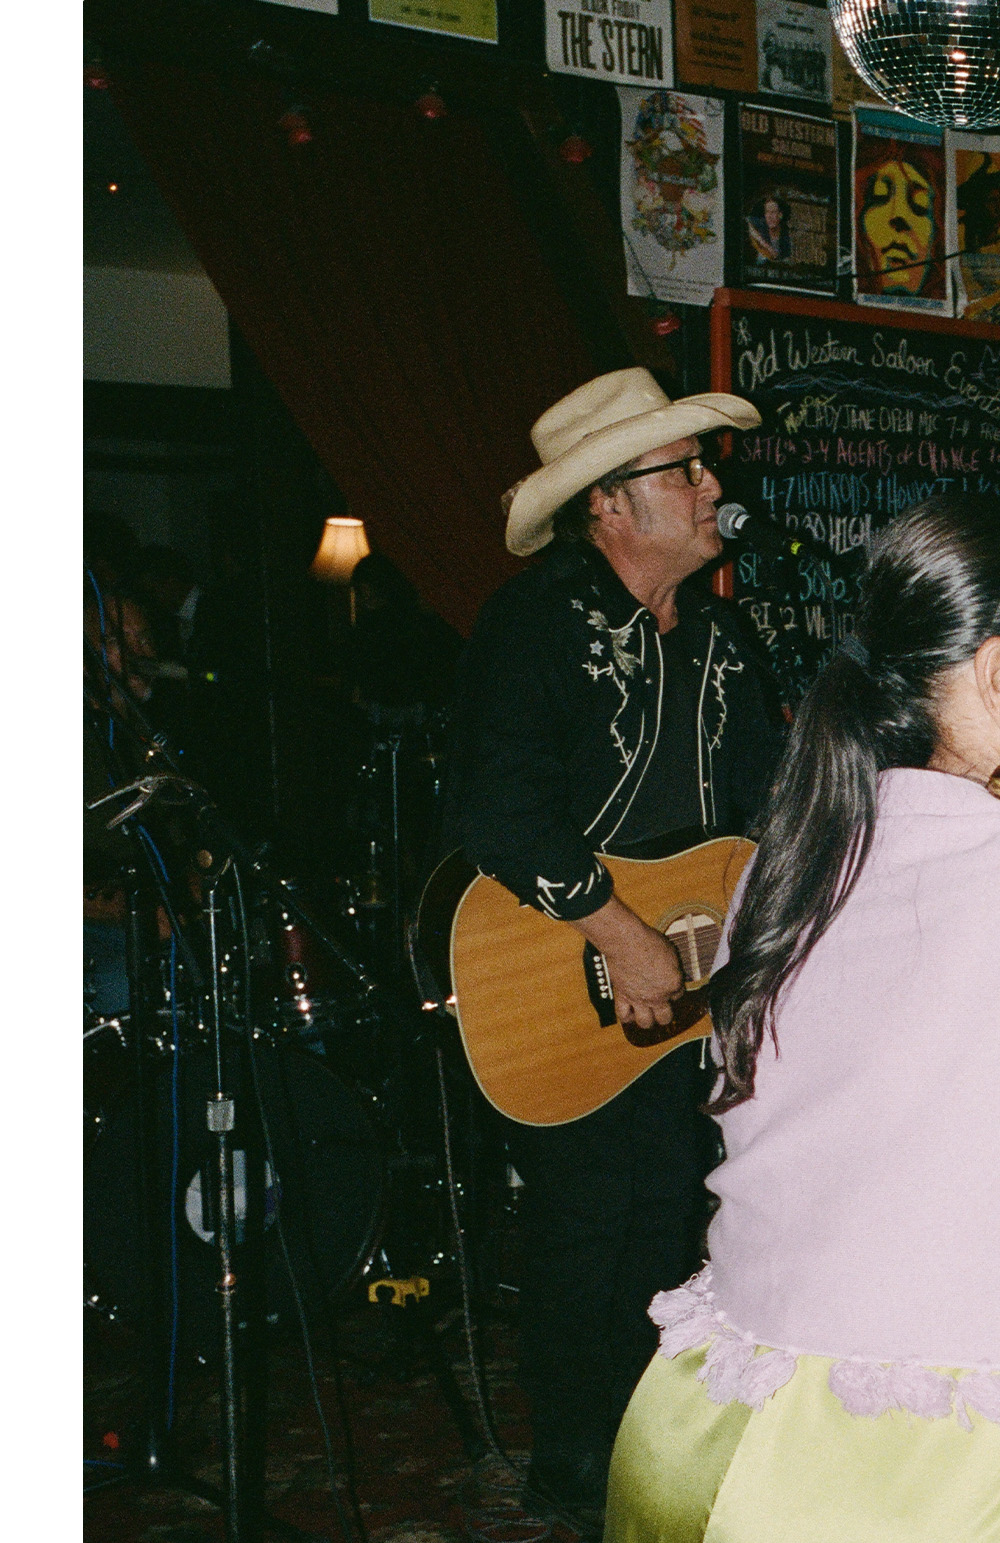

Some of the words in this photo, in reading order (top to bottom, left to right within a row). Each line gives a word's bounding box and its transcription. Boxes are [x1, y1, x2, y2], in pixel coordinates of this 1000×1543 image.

[557, 10, 597, 70] THE
[741, 111, 769, 133] OLD
[774, 116, 836, 147] WESTERN
[783, 329, 864, 371] Western
[871, 332, 938, 378] Saloon
[879, 405, 914, 433] OPEN
